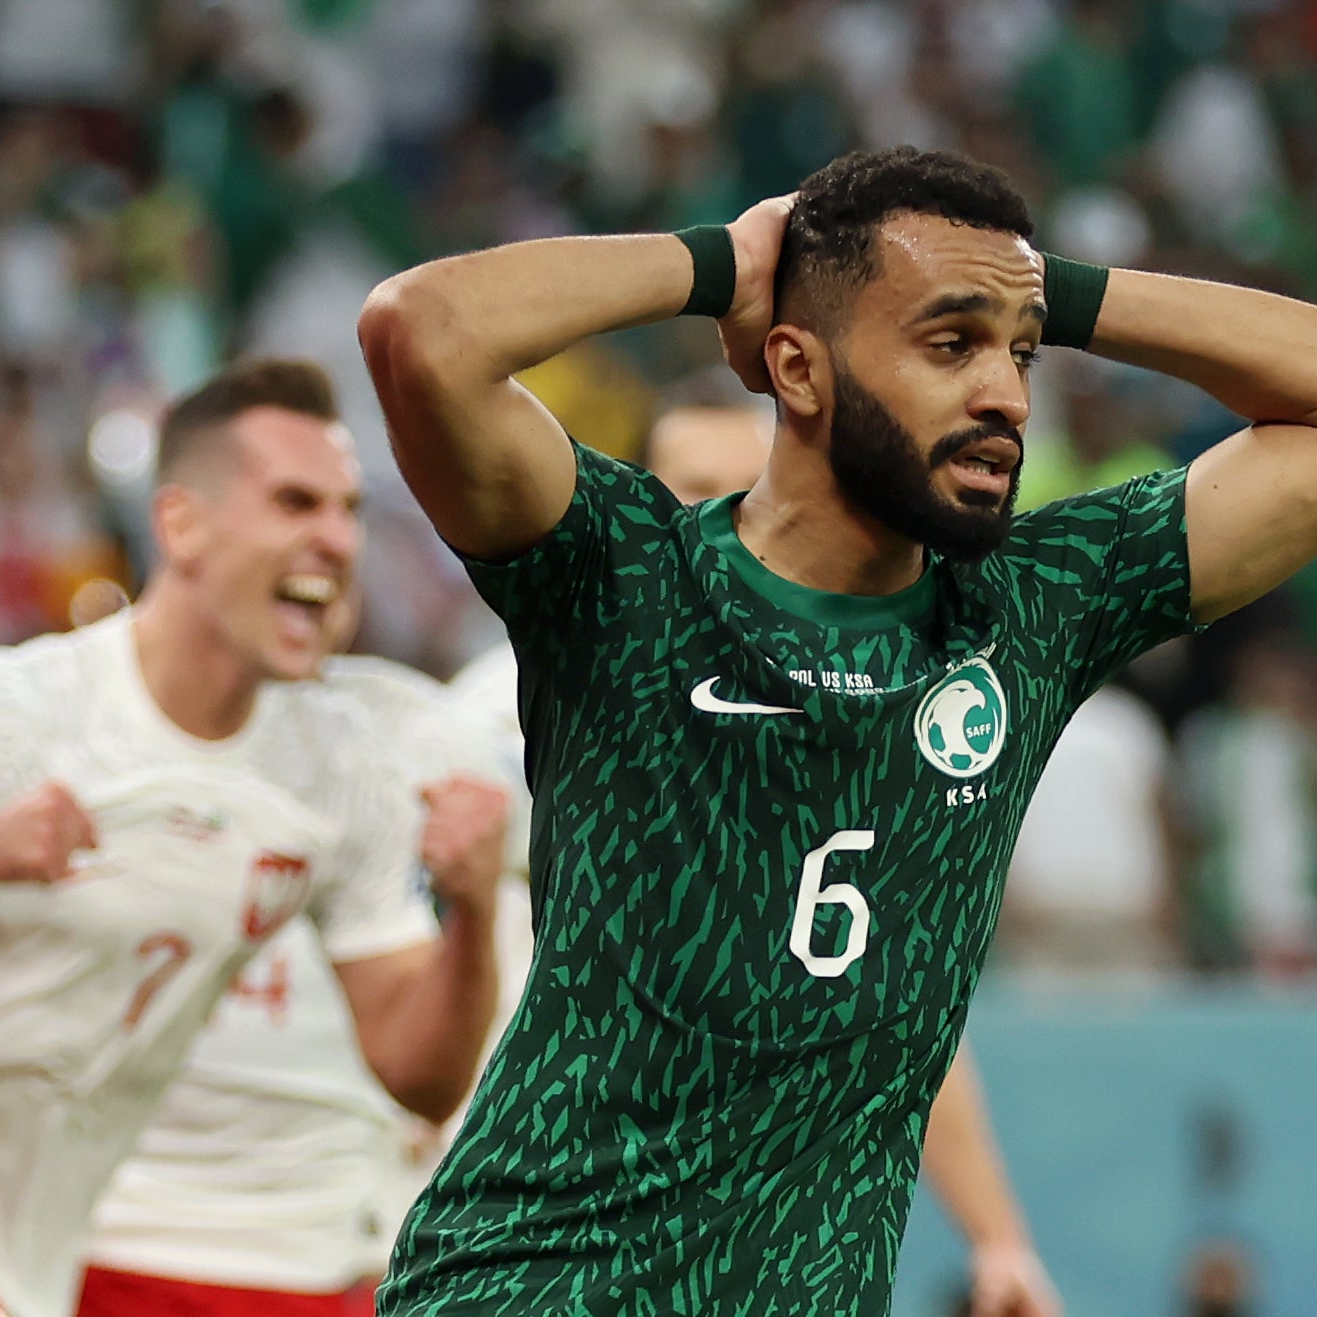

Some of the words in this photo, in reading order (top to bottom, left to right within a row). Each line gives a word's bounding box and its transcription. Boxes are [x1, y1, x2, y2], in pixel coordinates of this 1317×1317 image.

[845, 672, 874, 688] KSA
[966, 723, 991, 738] SAFF
[946, 783, 987, 807] KSA
[789, 830, 875, 978] 6
[124, 930, 191, 1030] 7
